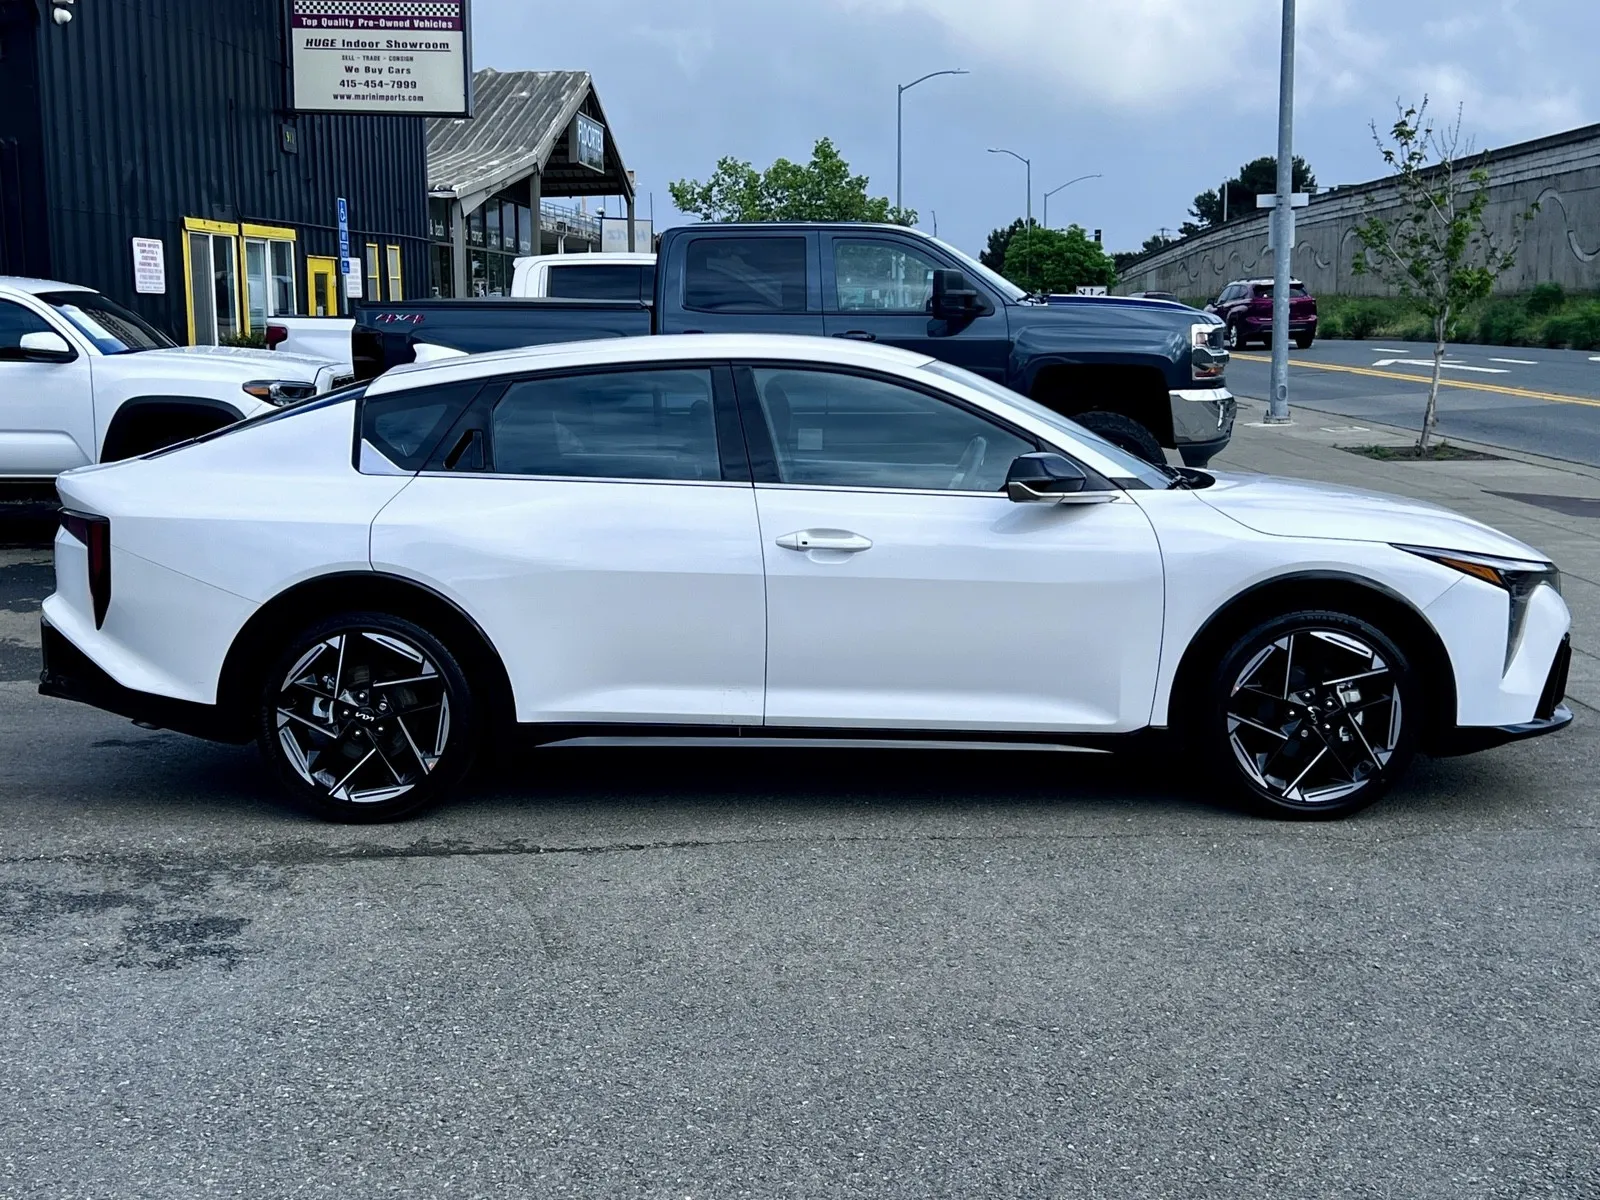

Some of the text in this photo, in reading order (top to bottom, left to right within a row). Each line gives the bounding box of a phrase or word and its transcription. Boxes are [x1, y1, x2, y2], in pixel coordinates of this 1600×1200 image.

[301, 17, 453, 29] Top Quality Pre-Owned Vehicles
[305, 38, 450, 50] HUGE Indoor Showroom
[344, 66, 412, 75] We Buy Cars
[339, 79, 417, 89] 415-454-7999
[332, 93, 424, 102] www.marinimports.com
